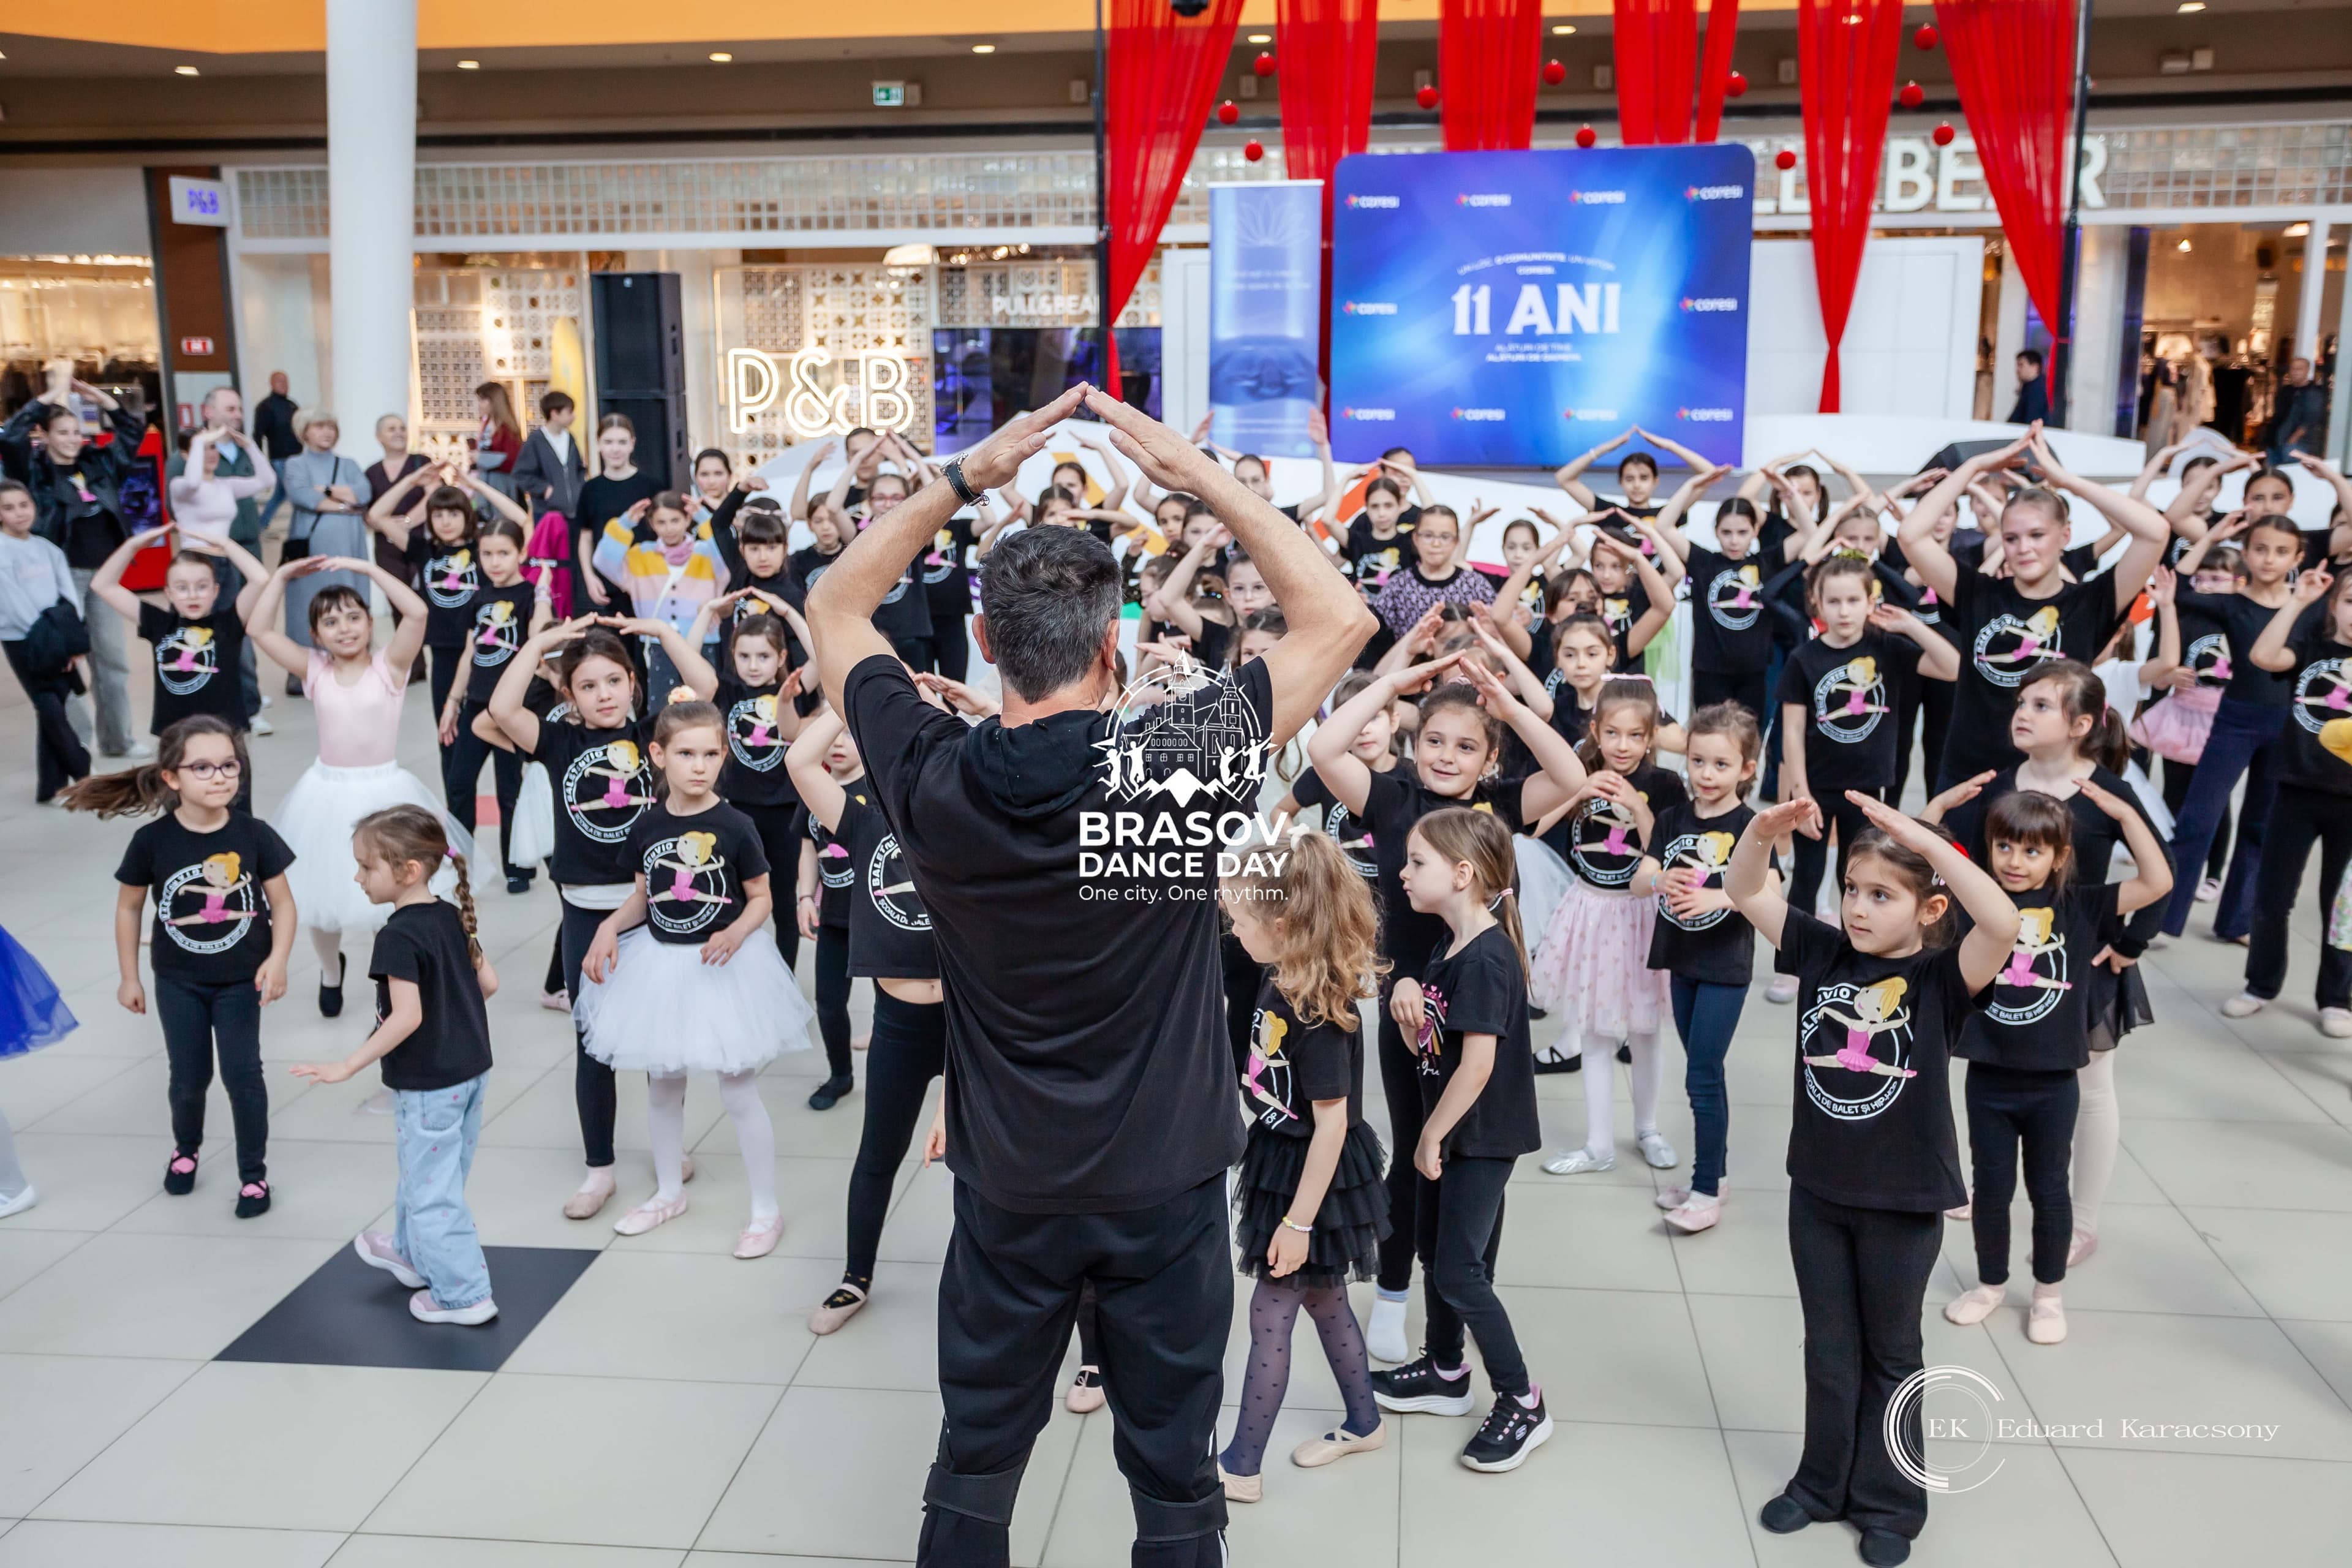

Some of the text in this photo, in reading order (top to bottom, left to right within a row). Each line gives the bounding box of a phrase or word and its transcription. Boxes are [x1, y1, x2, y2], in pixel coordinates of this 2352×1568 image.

[1450, 282, 1623, 335] 11 ANI
[728, 347, 915, 438] P&B
[1831, 1103, 1860, 1115] BALET
